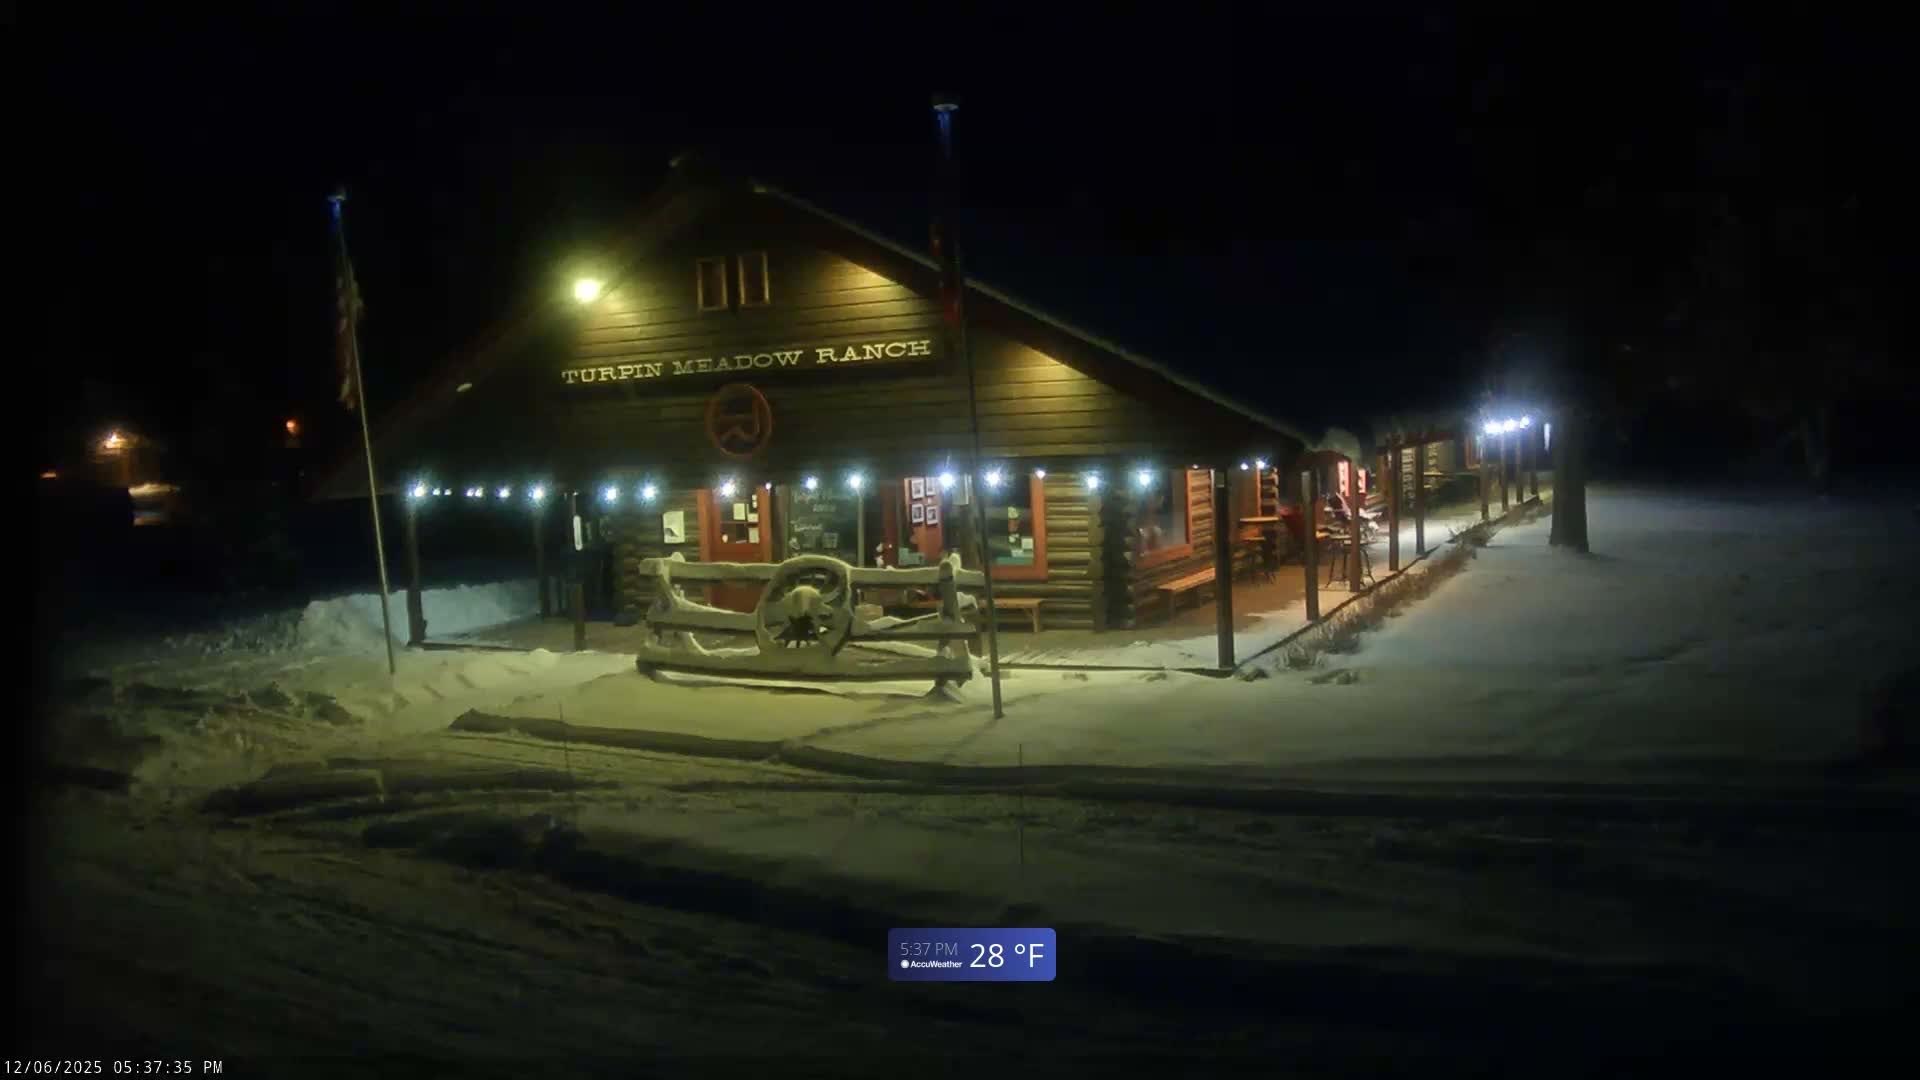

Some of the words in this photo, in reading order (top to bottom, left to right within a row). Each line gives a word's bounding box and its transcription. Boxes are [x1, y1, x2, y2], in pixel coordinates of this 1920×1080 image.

[561, 363, 663, 384] TURPIN
[673, 351, 804, 375] MEADOW
[816, 340, 931, 364] RANCH
